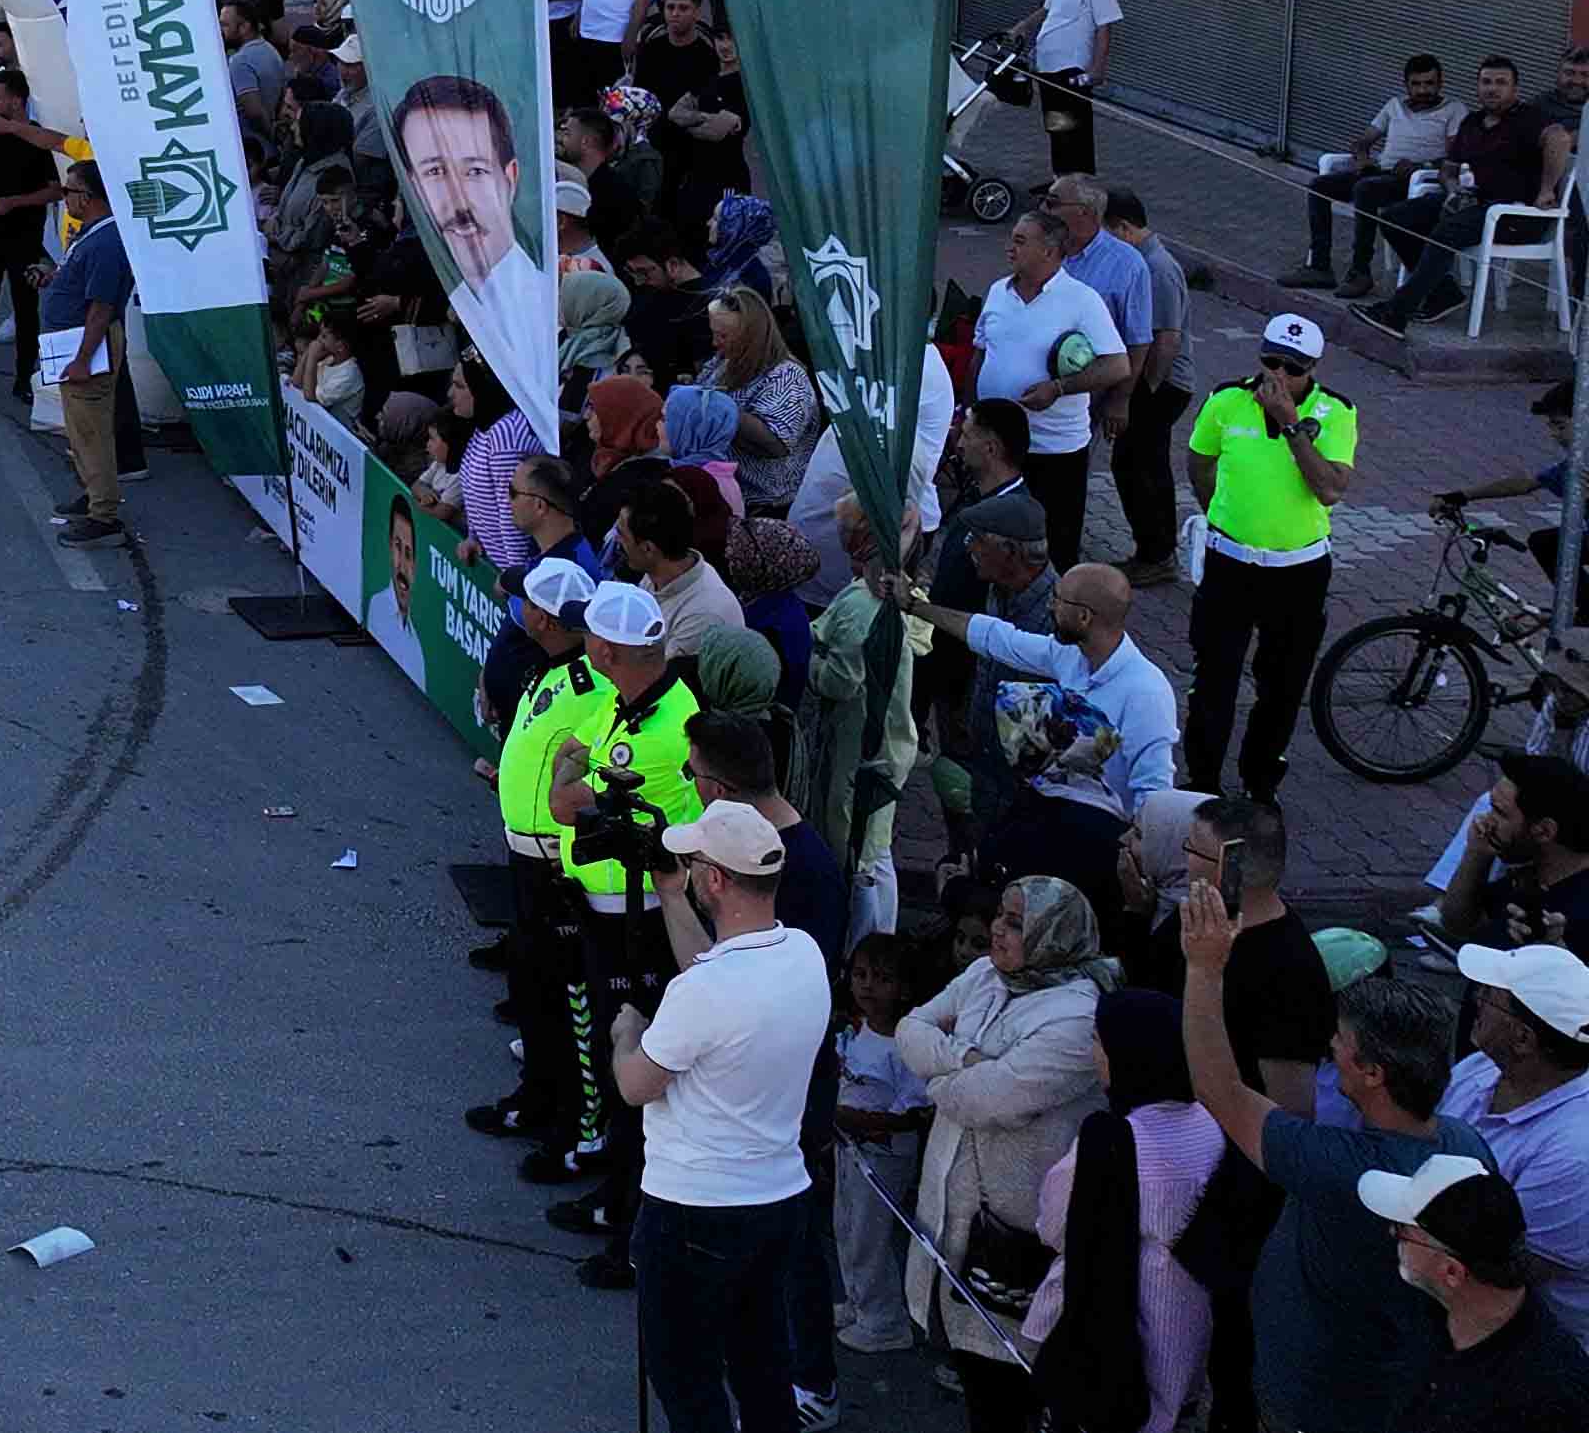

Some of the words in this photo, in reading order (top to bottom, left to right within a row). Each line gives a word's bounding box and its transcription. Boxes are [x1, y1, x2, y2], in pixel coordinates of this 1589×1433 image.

[297, 456, 338, 515] DİLERİM
[429, 543, 458, 600] TÜM
[461, 573, 507, 637] YARIŞ
